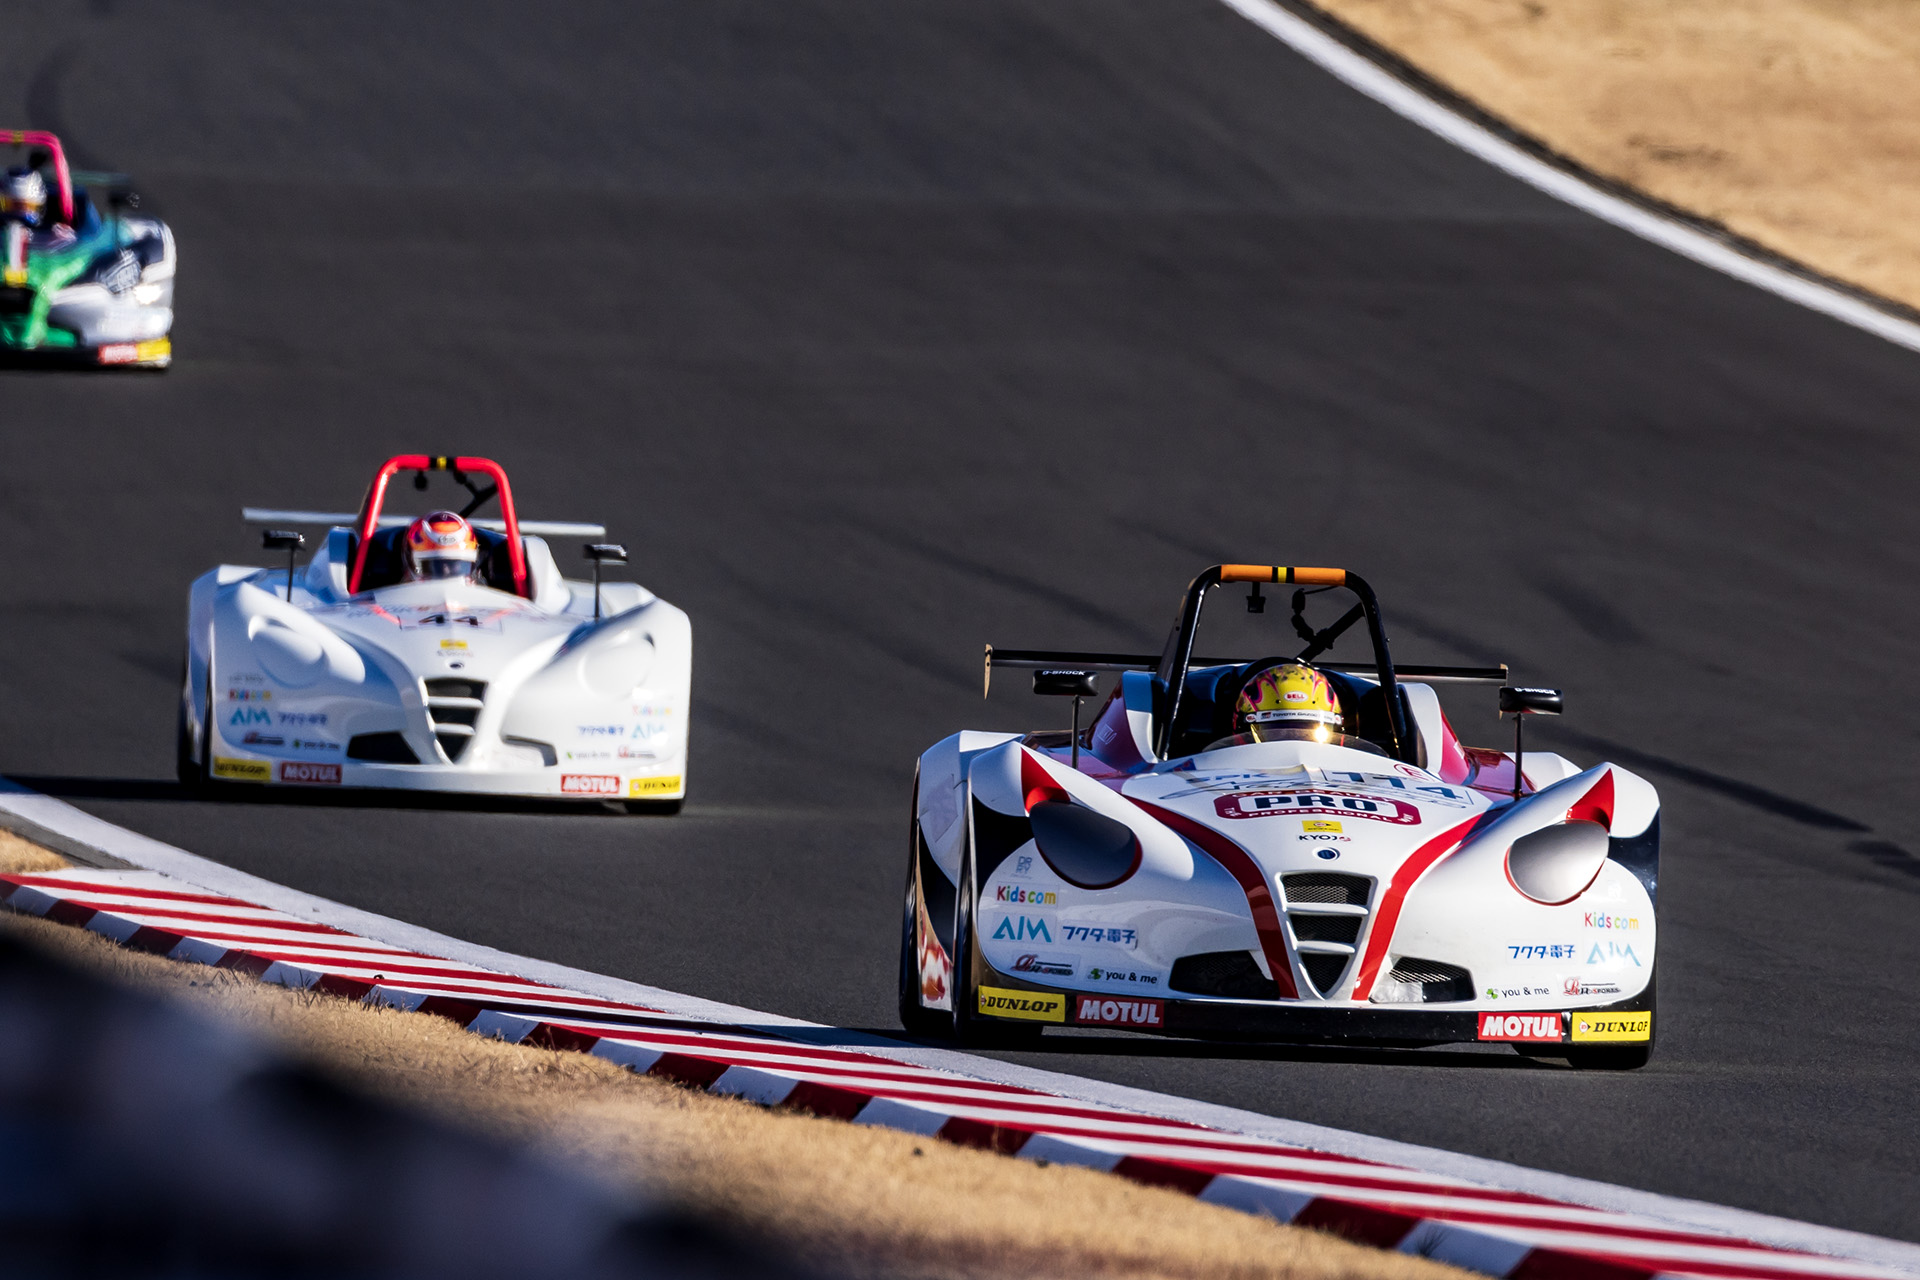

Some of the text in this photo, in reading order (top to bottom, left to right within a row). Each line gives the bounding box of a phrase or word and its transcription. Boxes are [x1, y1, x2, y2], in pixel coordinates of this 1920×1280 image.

[284, 765, 338, 781] MOTUL
[563, 777, 618, 792] MOTUL
[1252, 794, 1379, 812] PRO
[1247, 807, 1393, 823] PROFESSIONAL
[992, 914, 1052, 943] AIM
[1105, 970, 1158, 984] you & me
[1501, 987, 1521, 998] you
[1523, 985, 1532, 996] &
[1534, 986, 1550, 996] me
[986, 994, 1059, 1014] DUNLOP
[1078, 1000, 1160, 1025] MOTUL
[1481, 1015, 1560, 1038] MOTUL
[1593, 1021, 1648, 1033] DUNLOP
